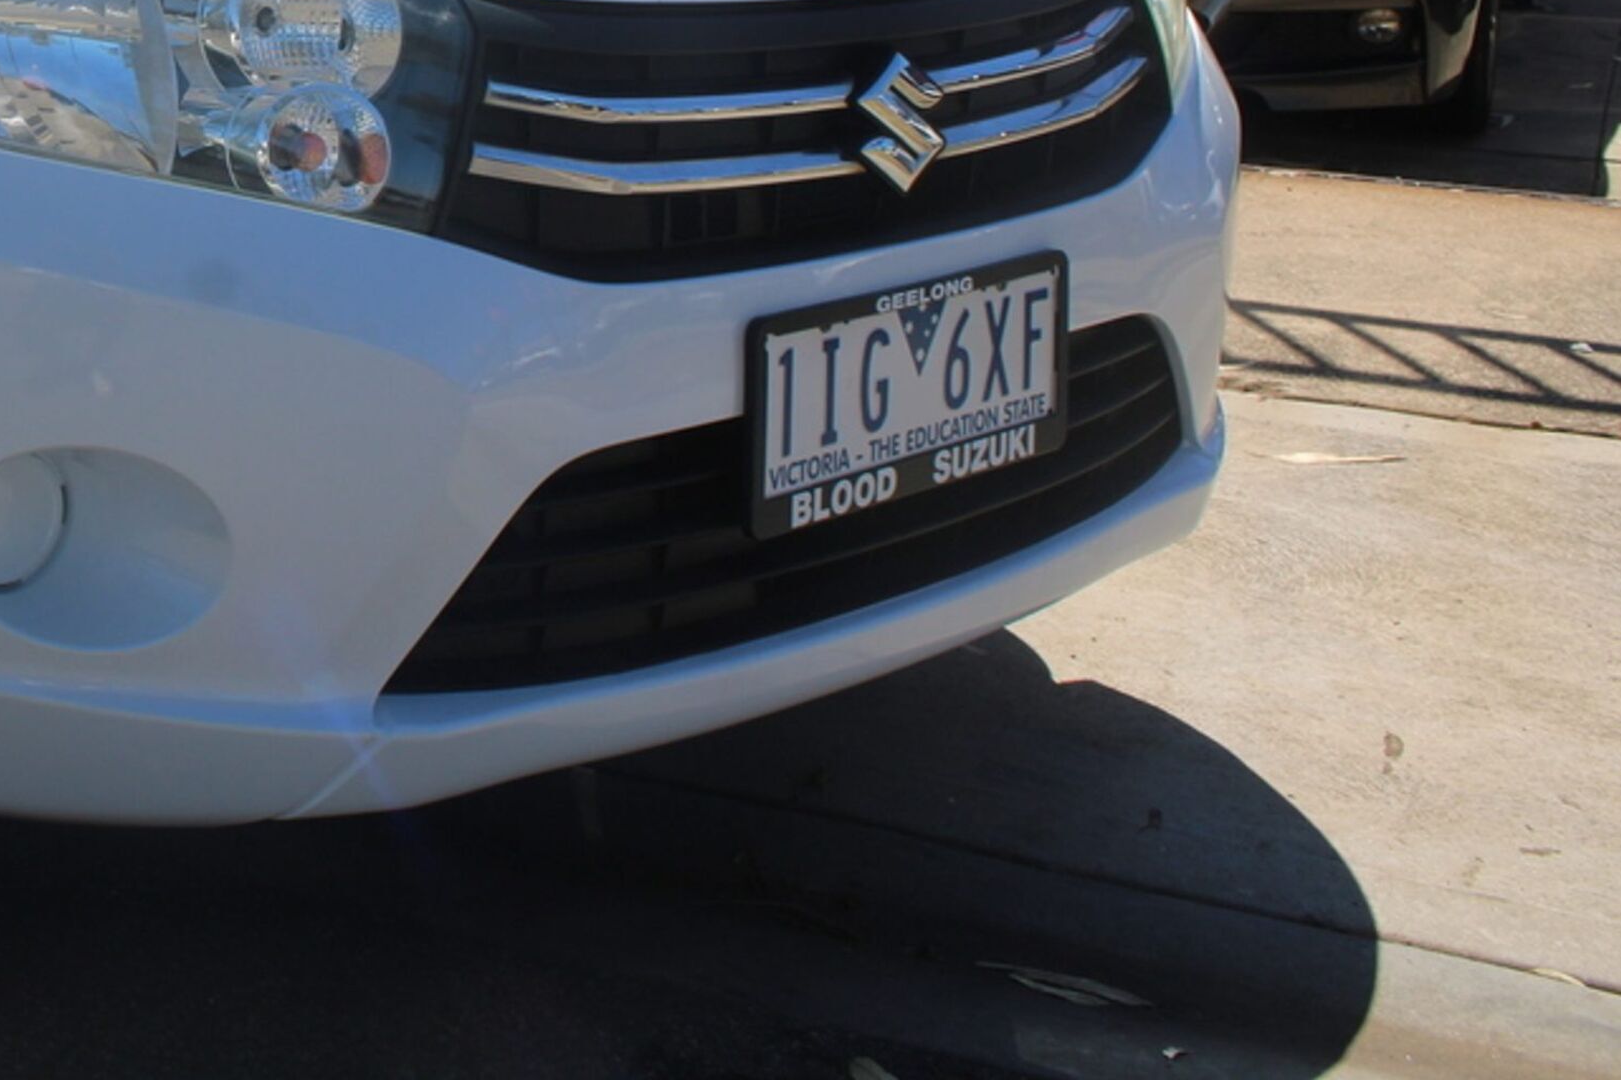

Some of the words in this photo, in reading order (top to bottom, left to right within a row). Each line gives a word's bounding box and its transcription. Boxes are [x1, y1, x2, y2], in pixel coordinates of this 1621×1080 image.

[876, 277, 975, 313] GEELONG
[768, 449, 851, 491] VICTORIA
[869, 435, 901, 462] THE
[906, 409, 999, 453] EDUCATION
[1004, 394, 1047, 423] STATE
[791, 467, 898, 528] BLOOD
[933, 424, 1036, 484] SUZUKI
